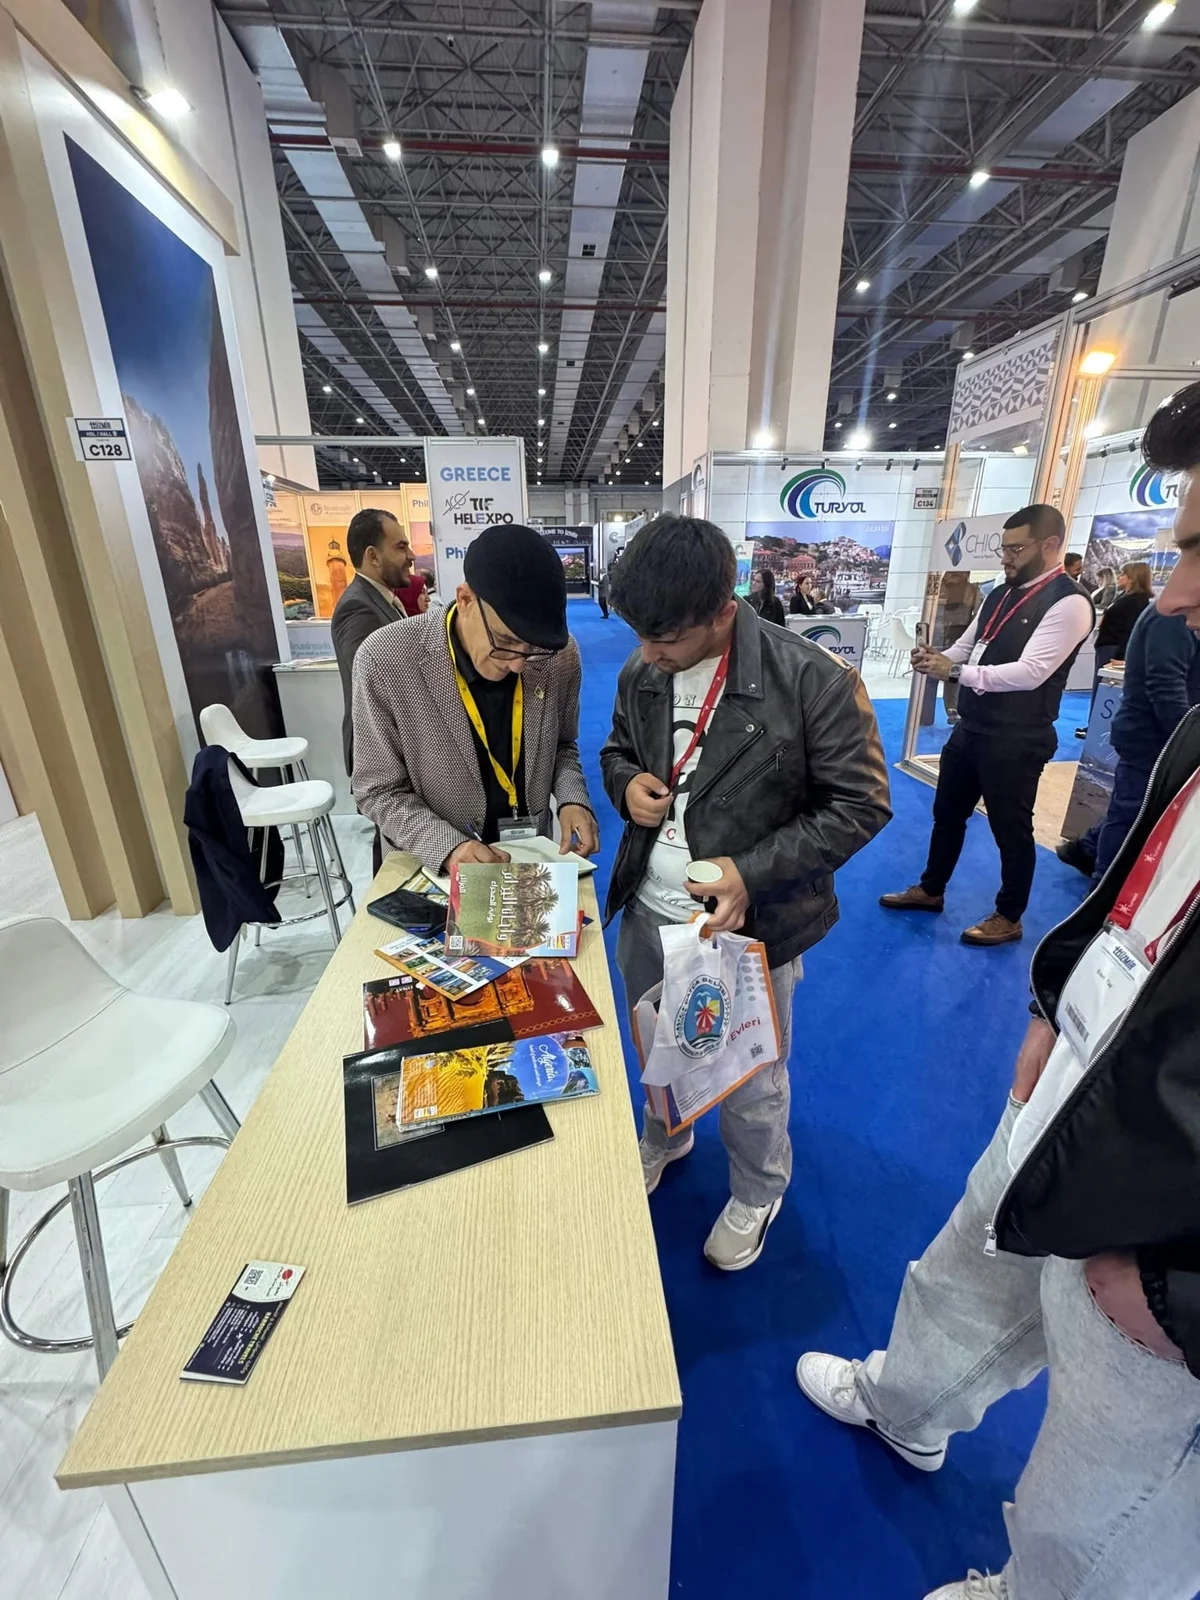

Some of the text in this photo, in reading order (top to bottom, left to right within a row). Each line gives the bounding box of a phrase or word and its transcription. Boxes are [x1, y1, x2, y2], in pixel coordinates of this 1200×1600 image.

[89, 444, 123, 456] C128
[440, 467, 511, 482] GREECE
[412, 499, 428, 507] Phil
[469, 498, 494, 511] TIF
[814, 502, 866, 514] TURYOL
[454, 513, 514, 525] HELEXPO
[445, 547, 467, 559] Phi
[828, 646, 856, 654] RYOL
[729, 1017, 761, 1043] Evleri
